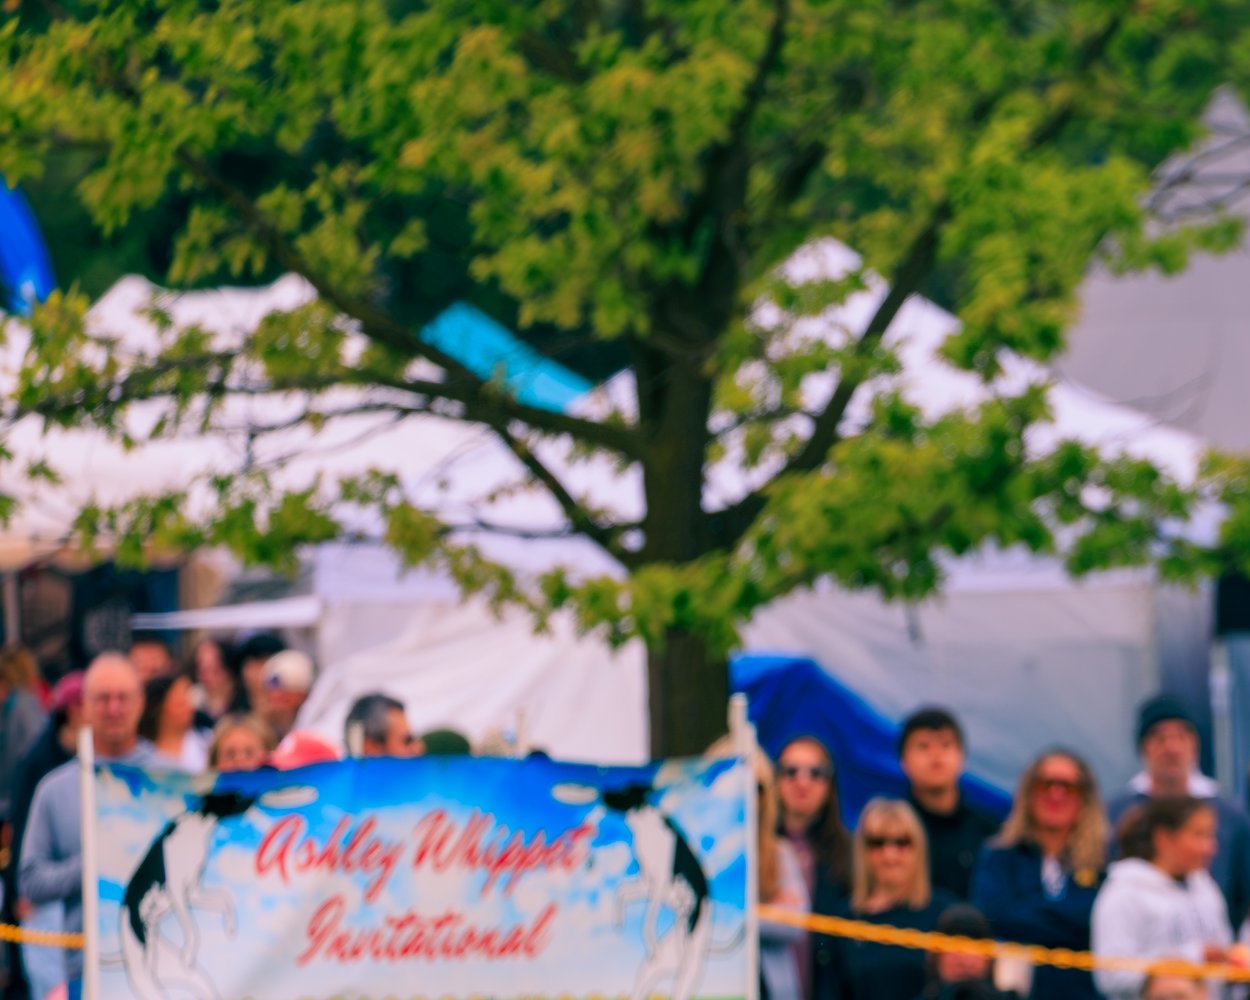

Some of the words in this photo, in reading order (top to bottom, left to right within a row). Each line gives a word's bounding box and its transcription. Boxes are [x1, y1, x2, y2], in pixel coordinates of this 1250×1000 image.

[254, 811, 405, 904] Ashley
[411, 806, 598, 898] Whippet
[295, 893, 559, 969] Invitational
